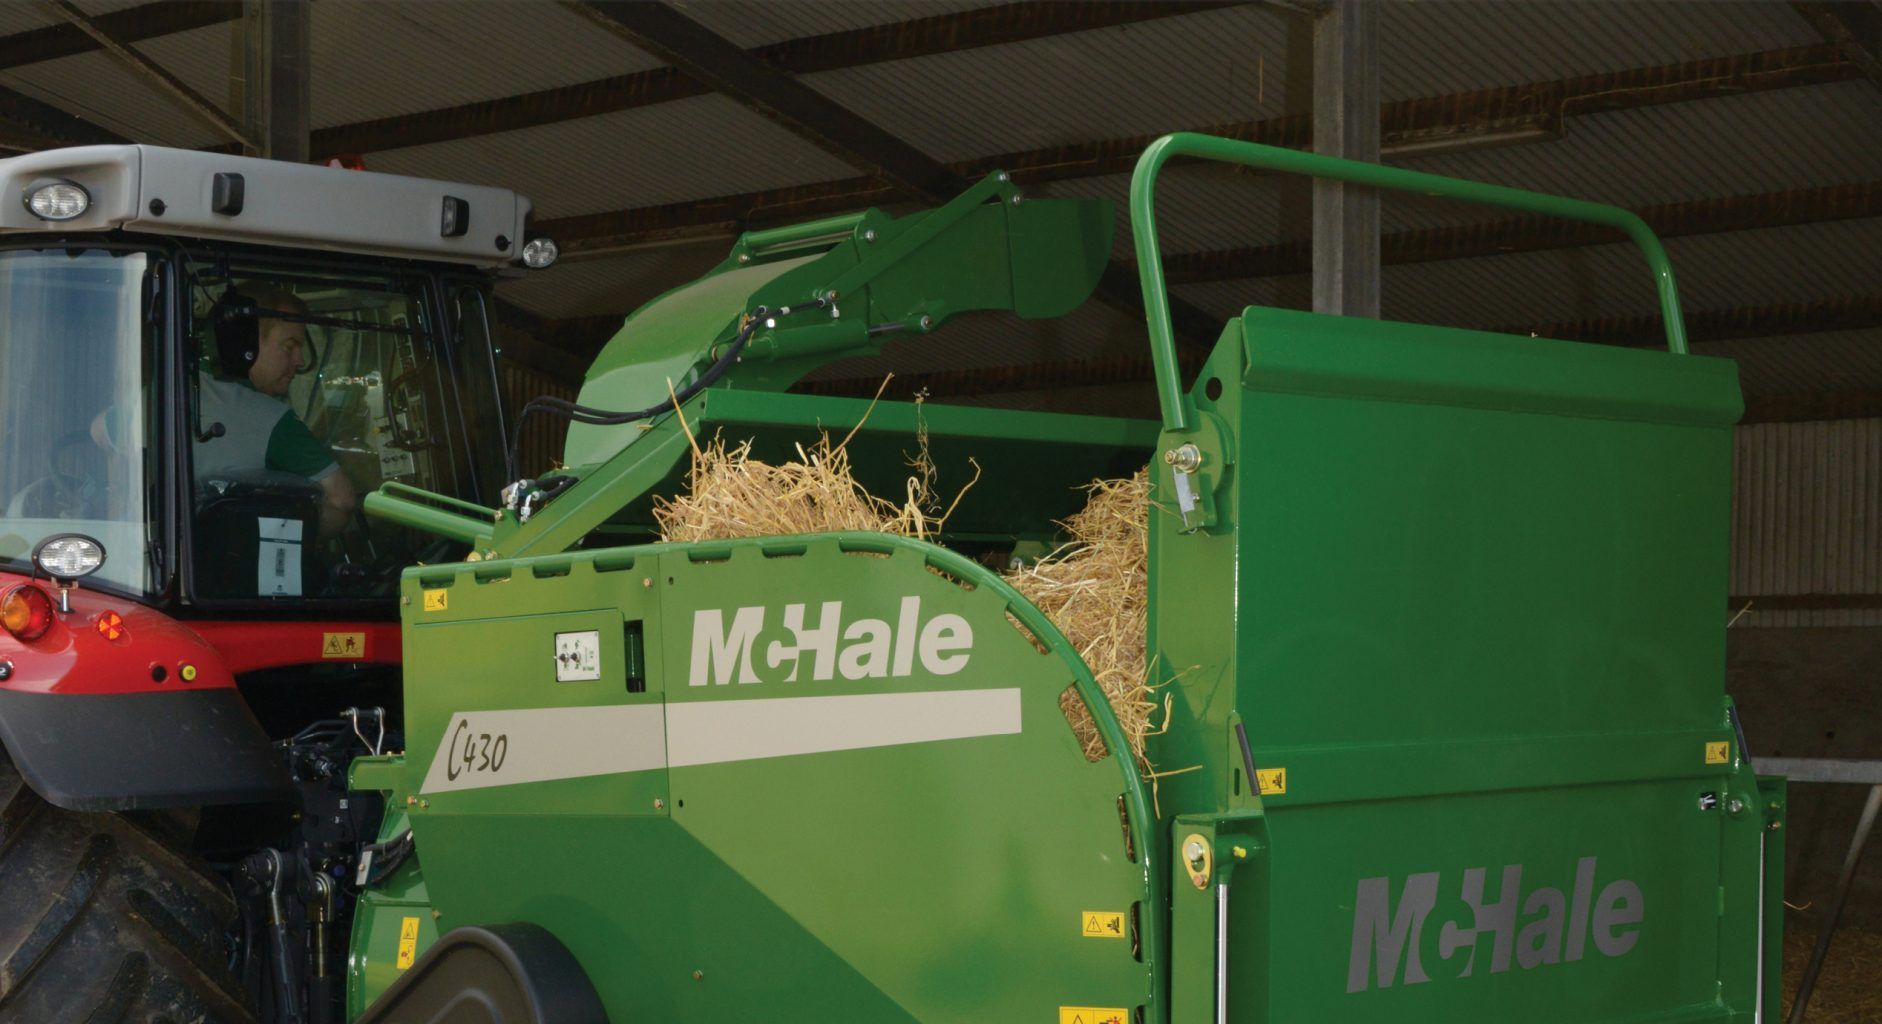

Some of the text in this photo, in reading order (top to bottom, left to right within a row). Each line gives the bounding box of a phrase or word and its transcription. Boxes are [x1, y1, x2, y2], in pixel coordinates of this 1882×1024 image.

[689, 596, 974, 687] McHale
[448, 719, 508, 782] C430
[1347, 856, 1644, 993] McHale
